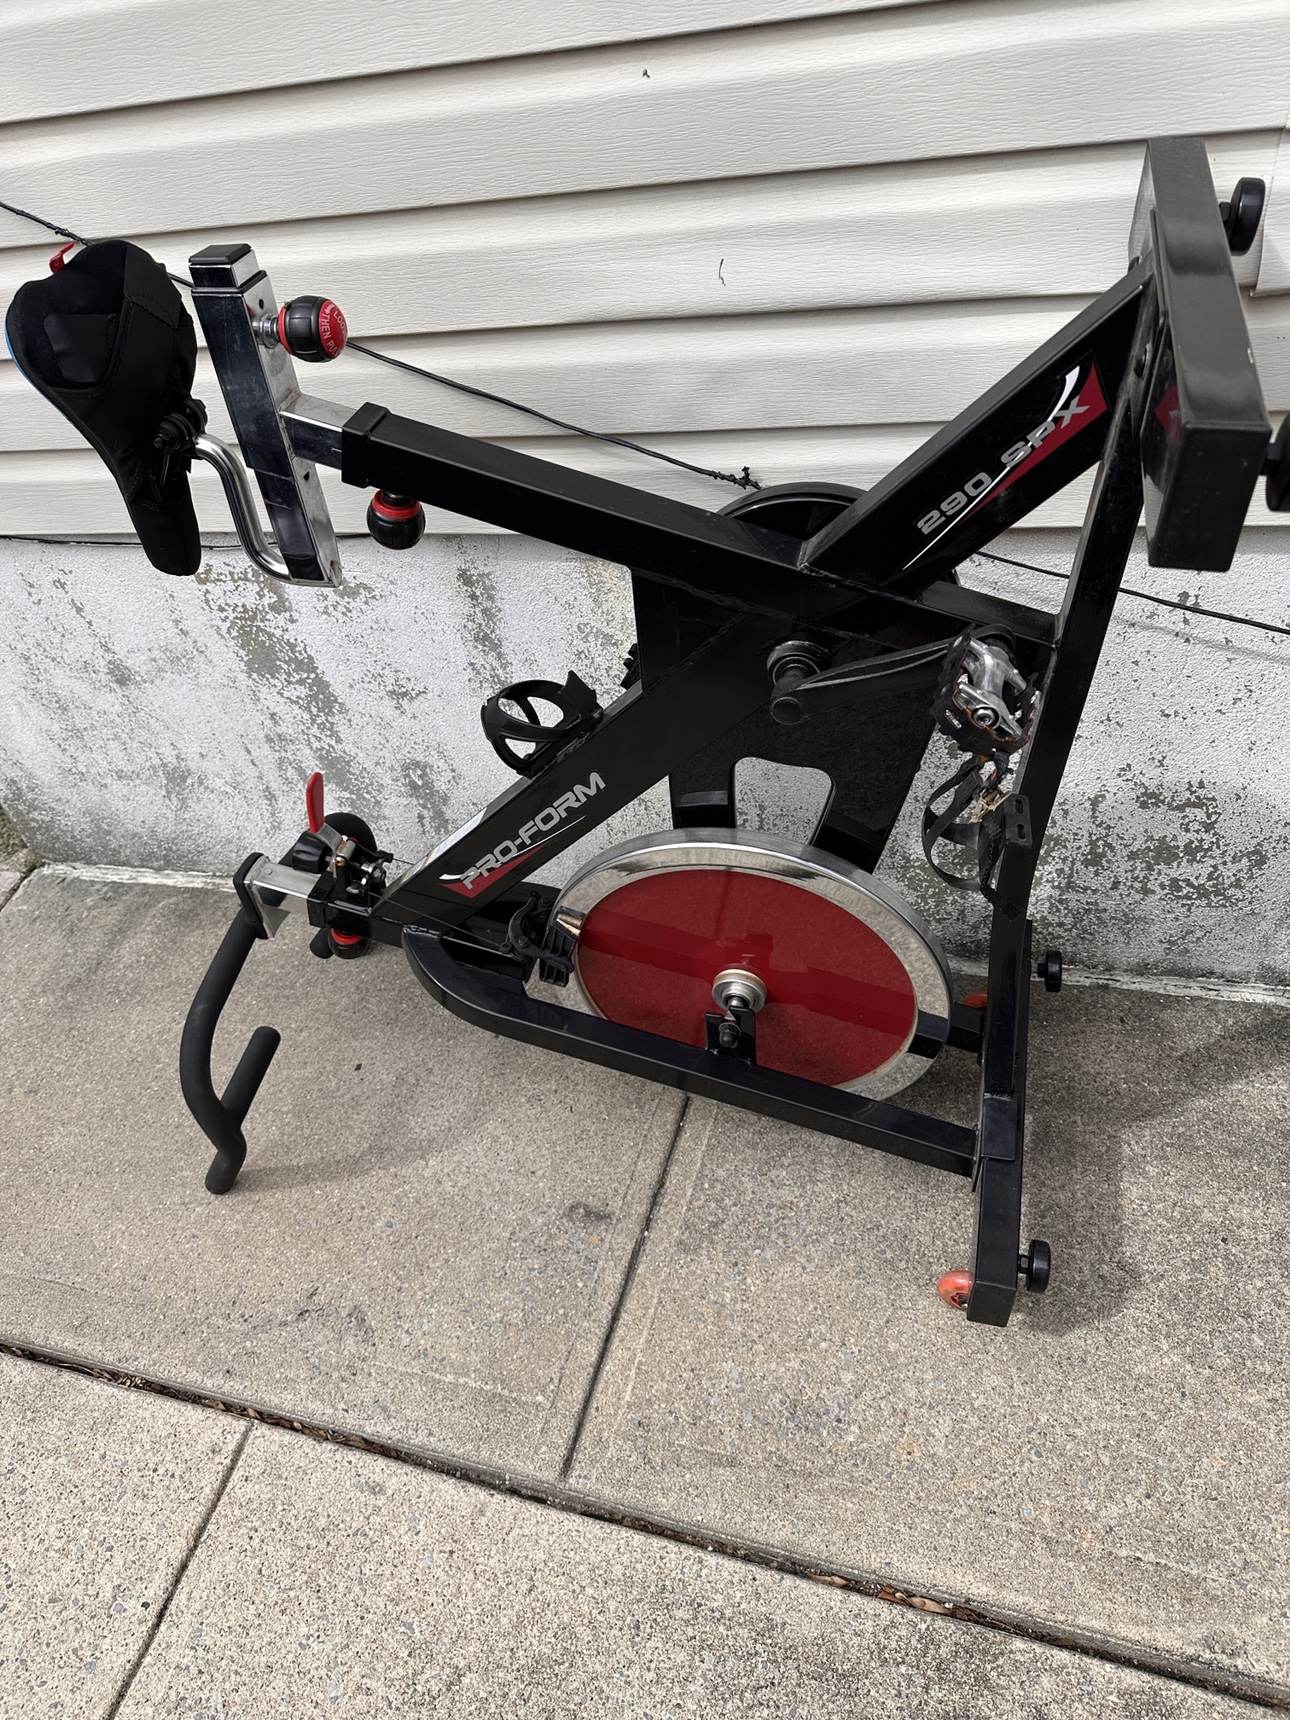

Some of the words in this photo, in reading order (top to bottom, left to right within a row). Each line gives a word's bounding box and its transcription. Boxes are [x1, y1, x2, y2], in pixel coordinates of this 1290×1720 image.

[321, 313, 332, 339] THEN
[917, 472, 993, 535] 290
[1000, 395, 1091, 467] SPX
[460, 772, 606, 890] PRO-FORM
